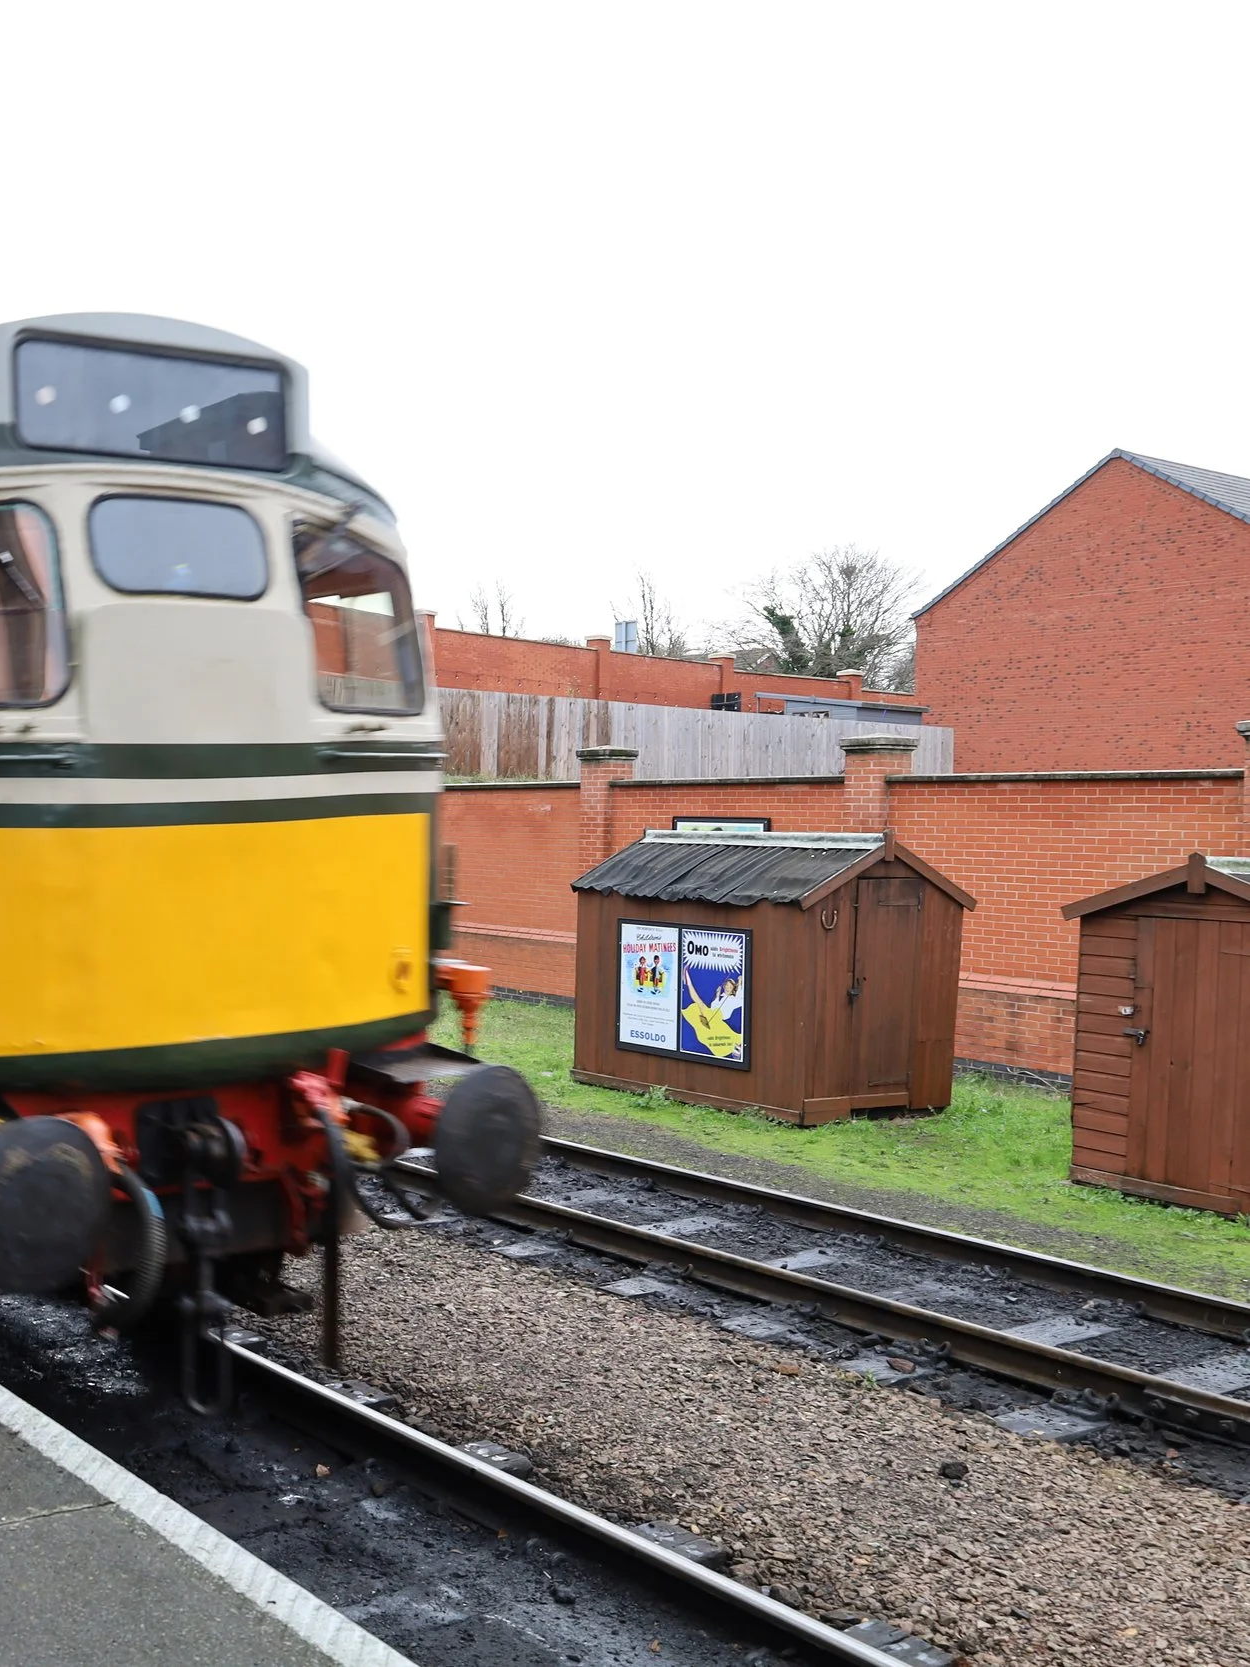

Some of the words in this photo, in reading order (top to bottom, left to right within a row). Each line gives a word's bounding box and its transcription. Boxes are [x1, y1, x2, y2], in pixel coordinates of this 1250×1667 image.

[623, 943, 647, 954] HOLIDAY
[648, 942, 677, 953] MATINEES
[630, 1029, 667, 1043] ESSOLDO
